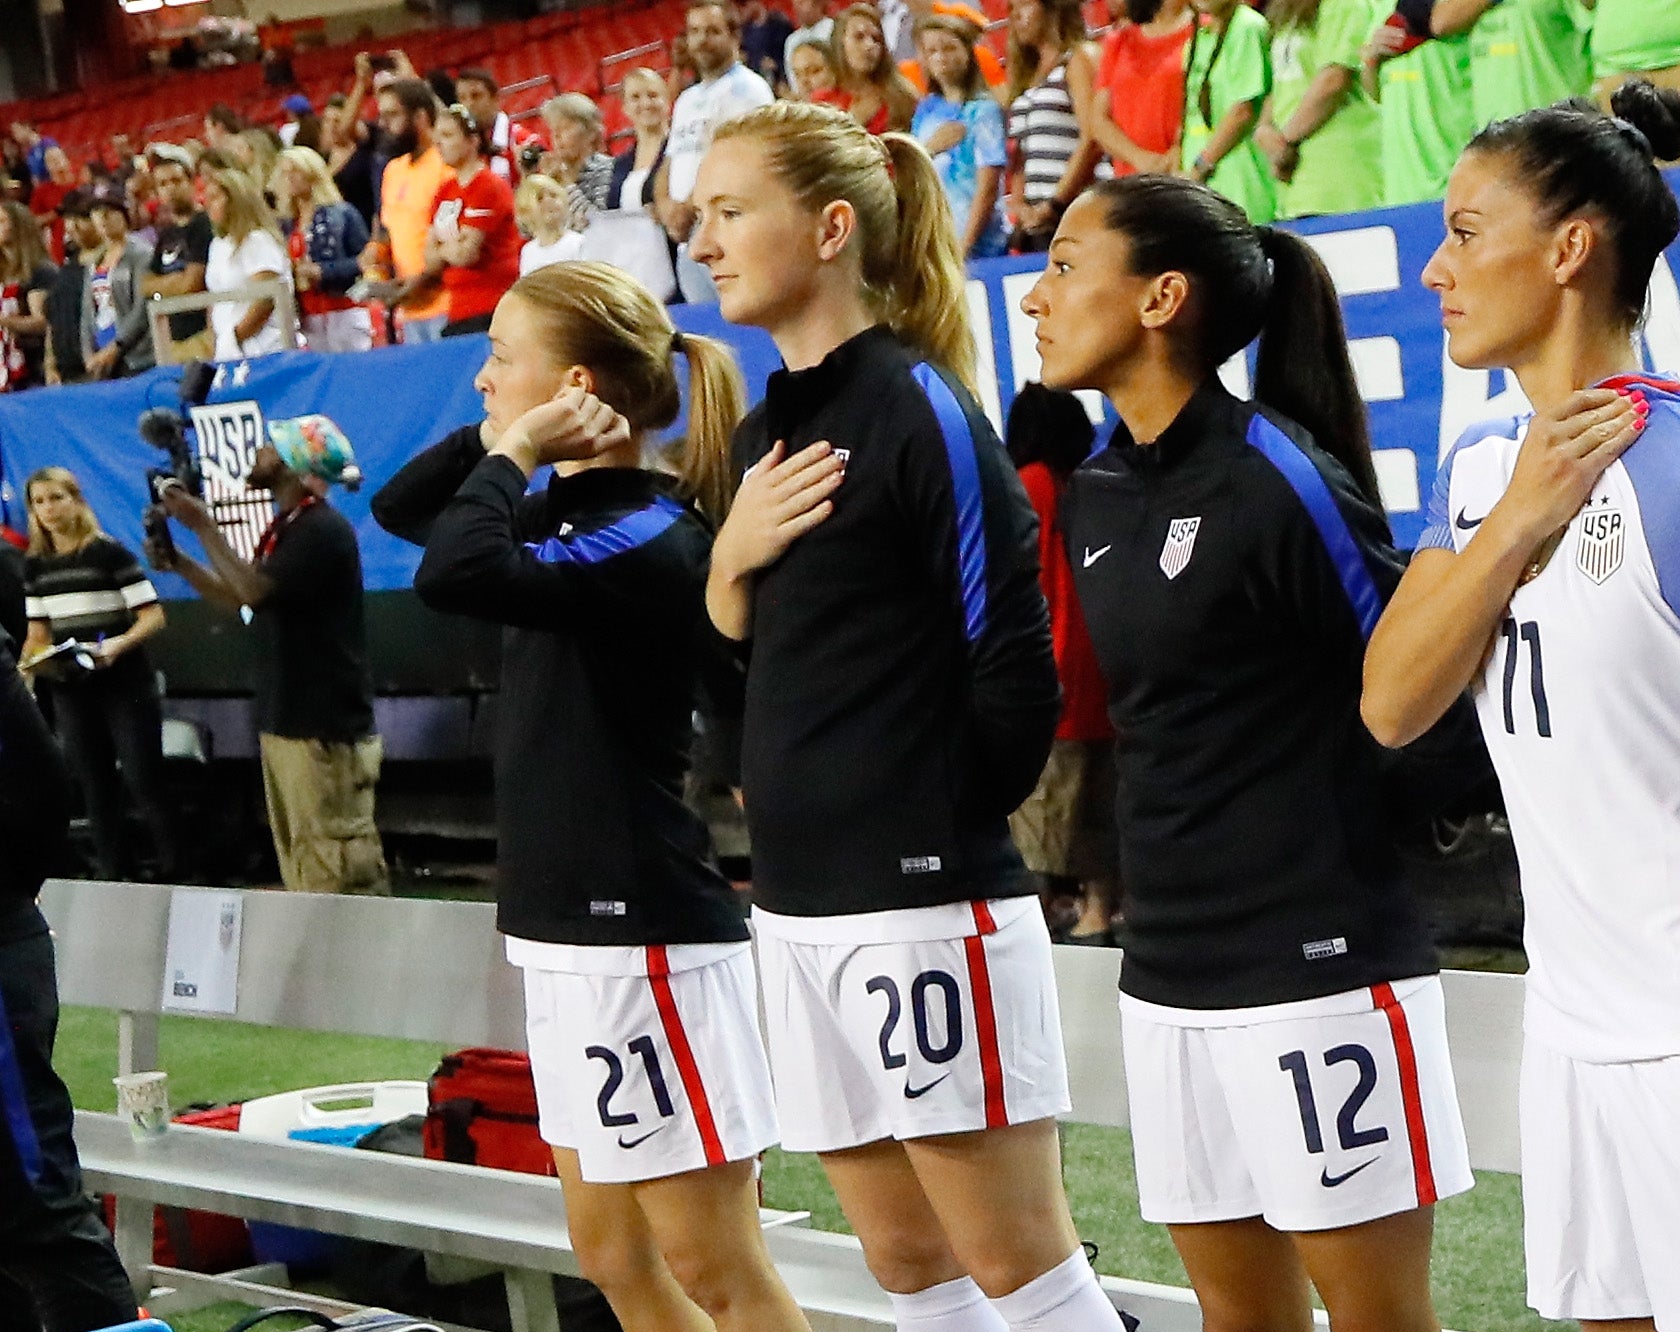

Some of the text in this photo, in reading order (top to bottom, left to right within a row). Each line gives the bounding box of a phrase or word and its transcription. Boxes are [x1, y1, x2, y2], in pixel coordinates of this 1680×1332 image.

[199, 414, 257, 479] USA
[1170, 520, 1198, 542] USA
[1584, 513, 1622, 540] USA
[1502, 617, 1552, 738] 11
[865, 970, 963, 1070] 20
[585, 1035, 675, 1127] 21
[1278, 1043, 1389, 1154] 12
